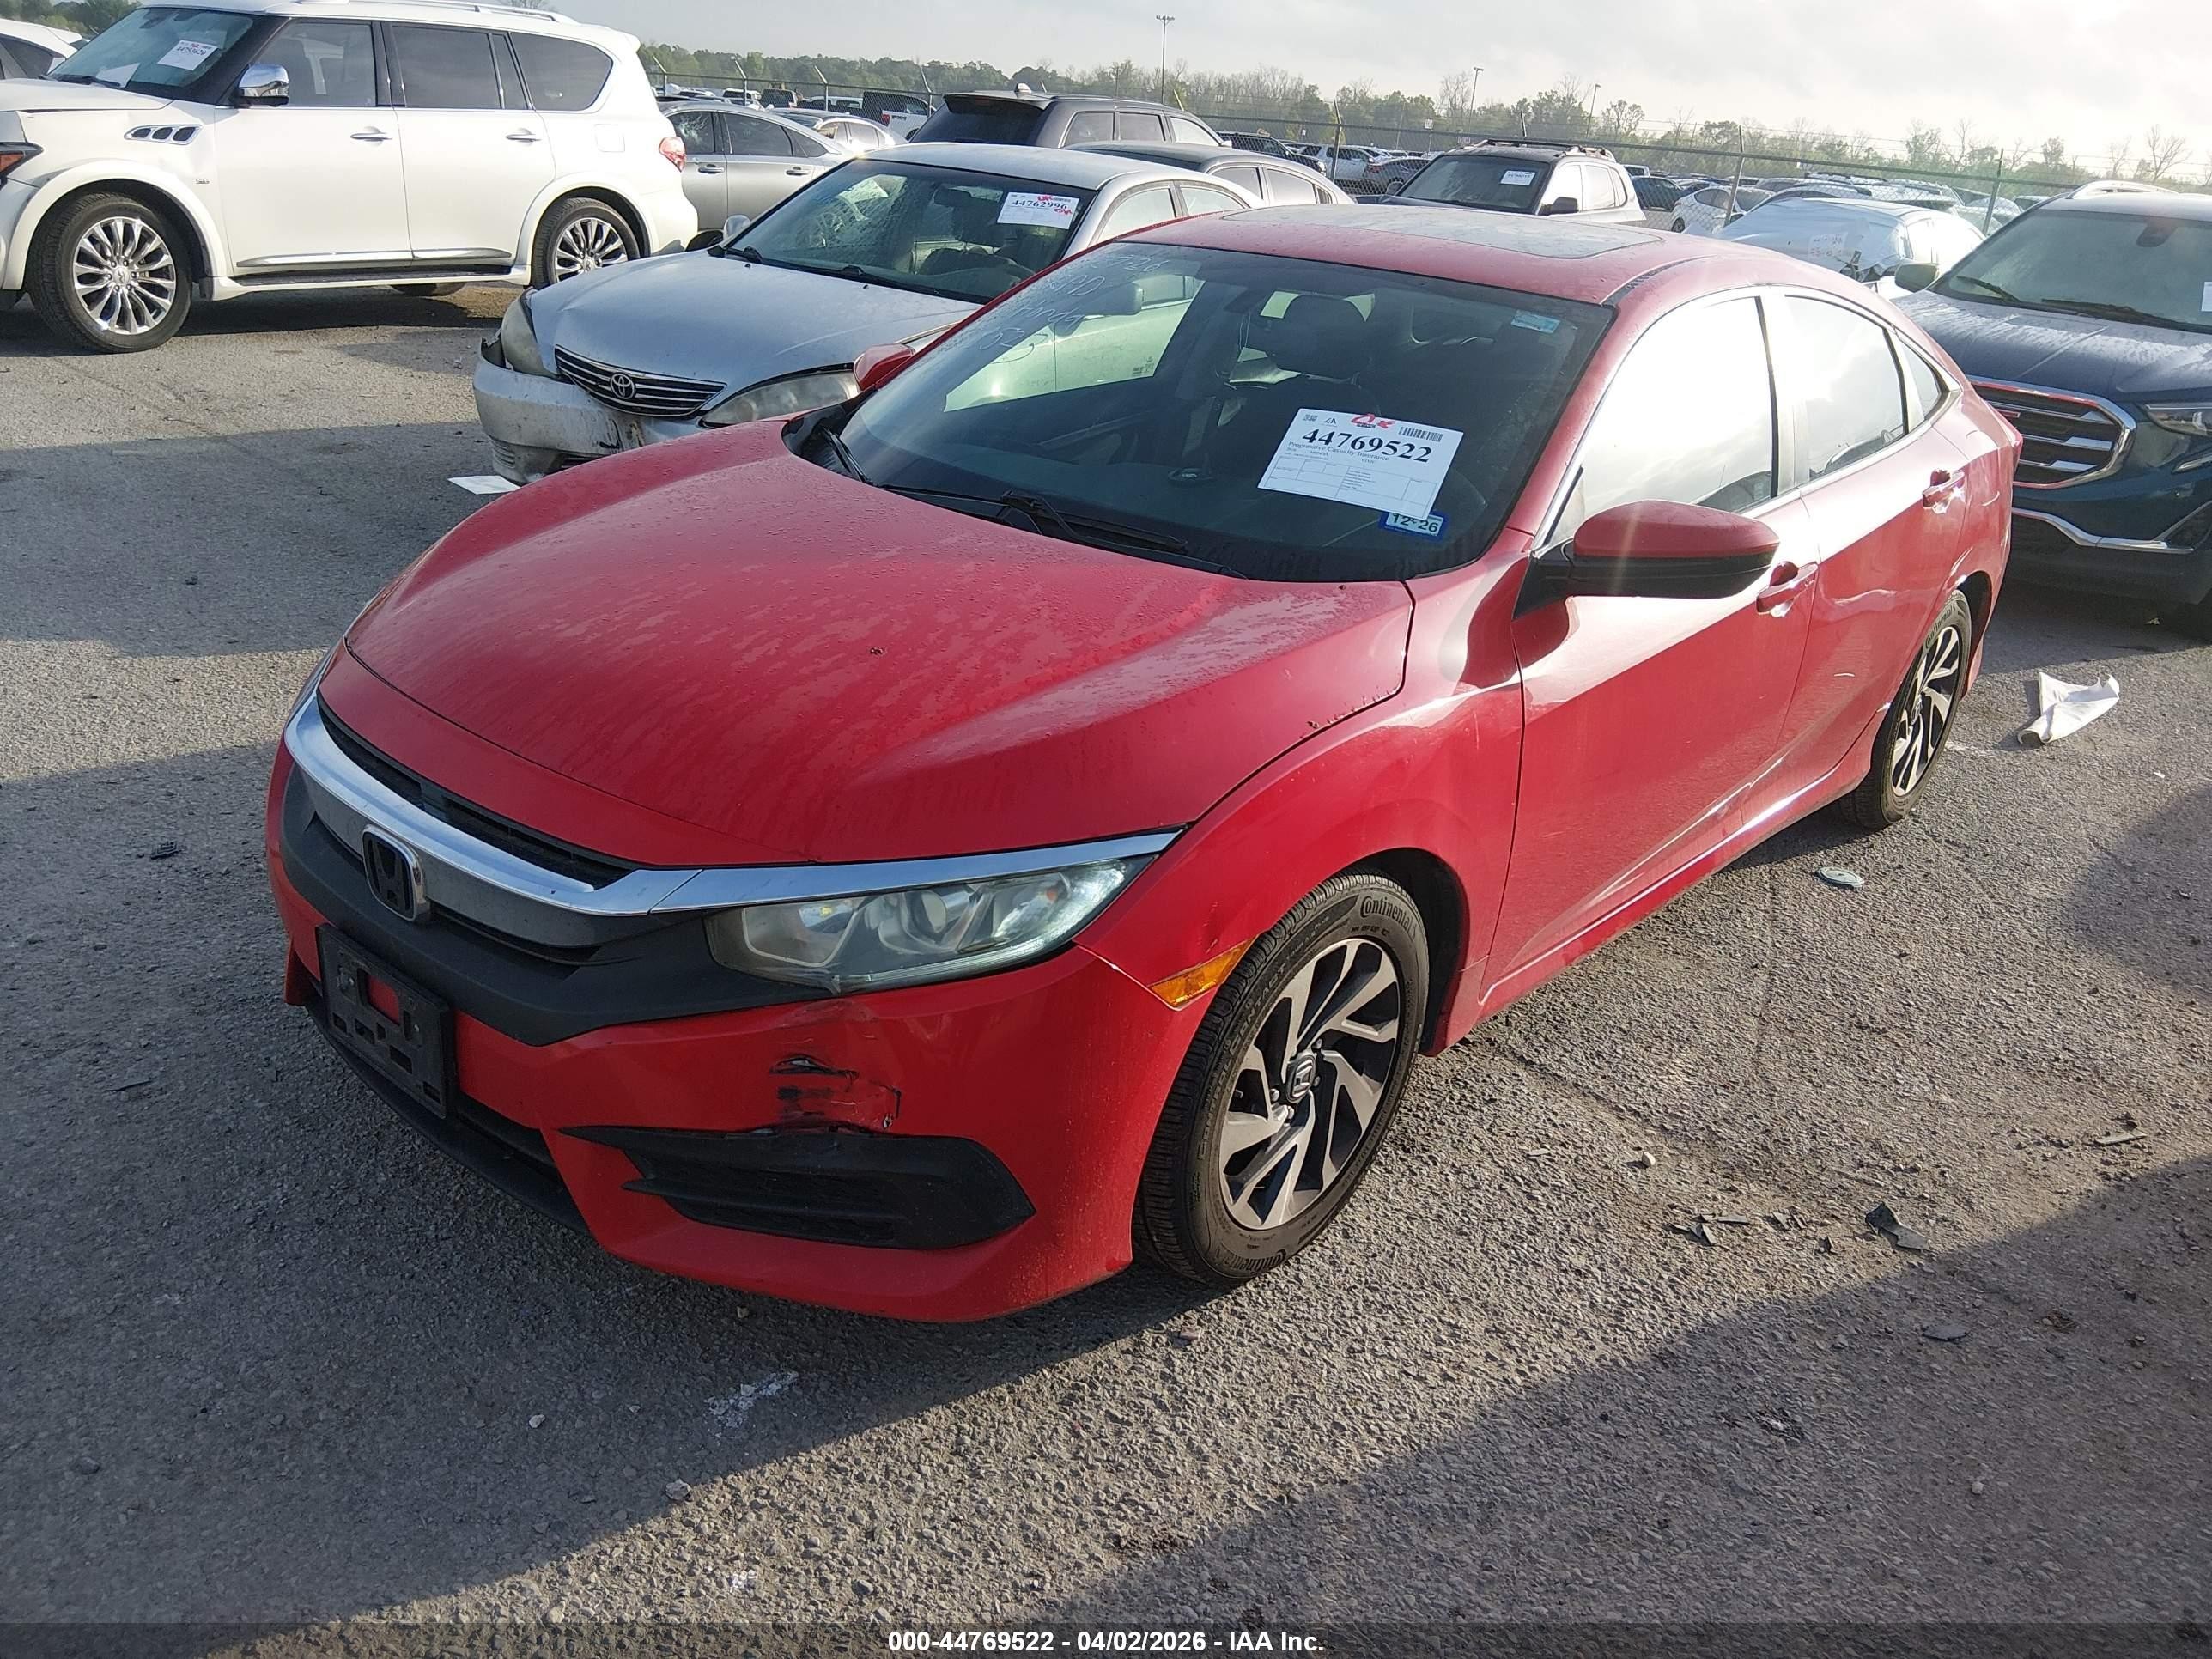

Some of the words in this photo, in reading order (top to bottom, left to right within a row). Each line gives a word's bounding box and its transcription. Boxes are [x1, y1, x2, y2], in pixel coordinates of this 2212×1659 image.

[1012, 199, 1068, 210] 44762996
[1288, 441, 1327, 451] Progressive
[1327, 446, 1355, 457] Casualty
[1357, 451, 1389, 461] Insurance
[1302, 428, 1432, 463] 44769522
[1360, 896, 1413, 934] Continental
